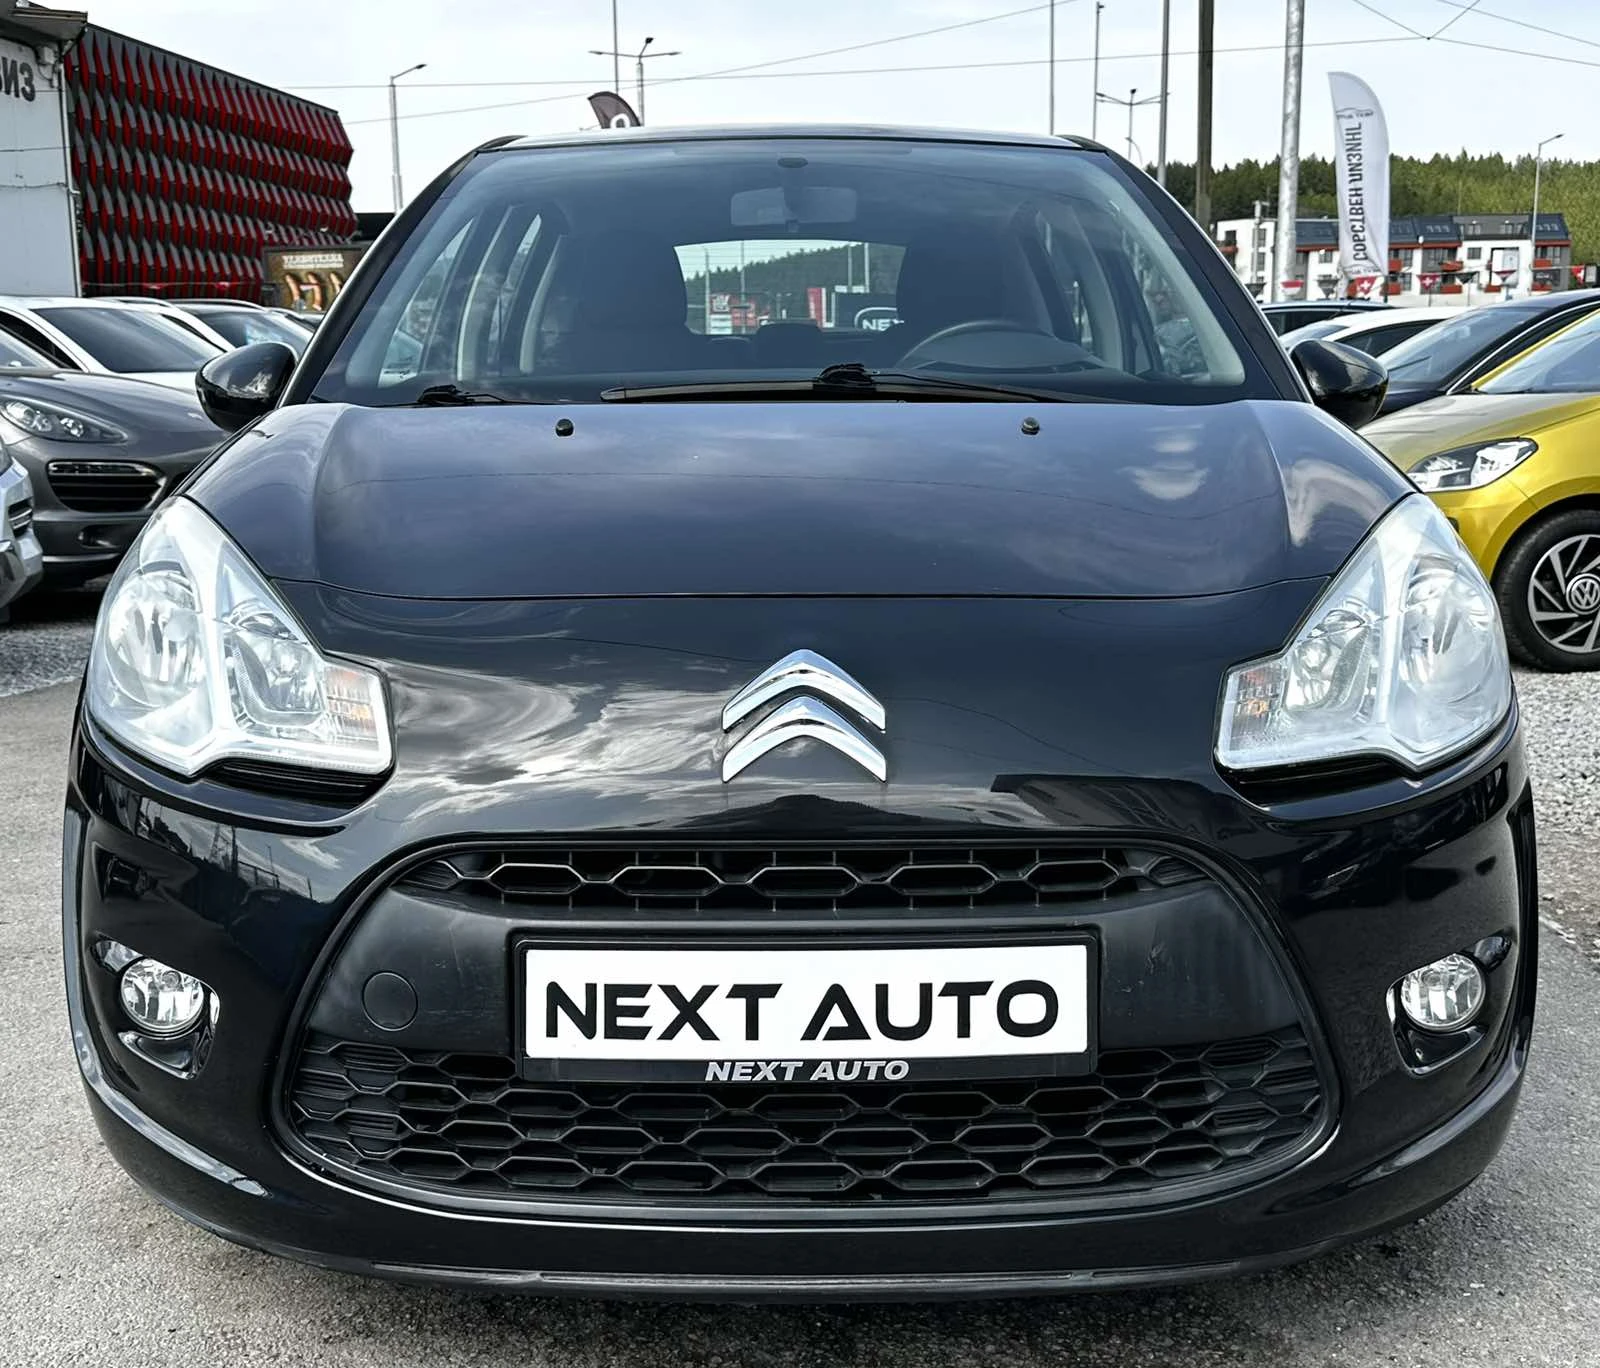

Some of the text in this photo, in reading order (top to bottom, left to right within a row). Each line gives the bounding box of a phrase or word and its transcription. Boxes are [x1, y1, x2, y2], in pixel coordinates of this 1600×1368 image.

[545, 979, 1059, 1041] NEXT AUTO
[705, 1060, 910, 1082] NEXT AUTO
